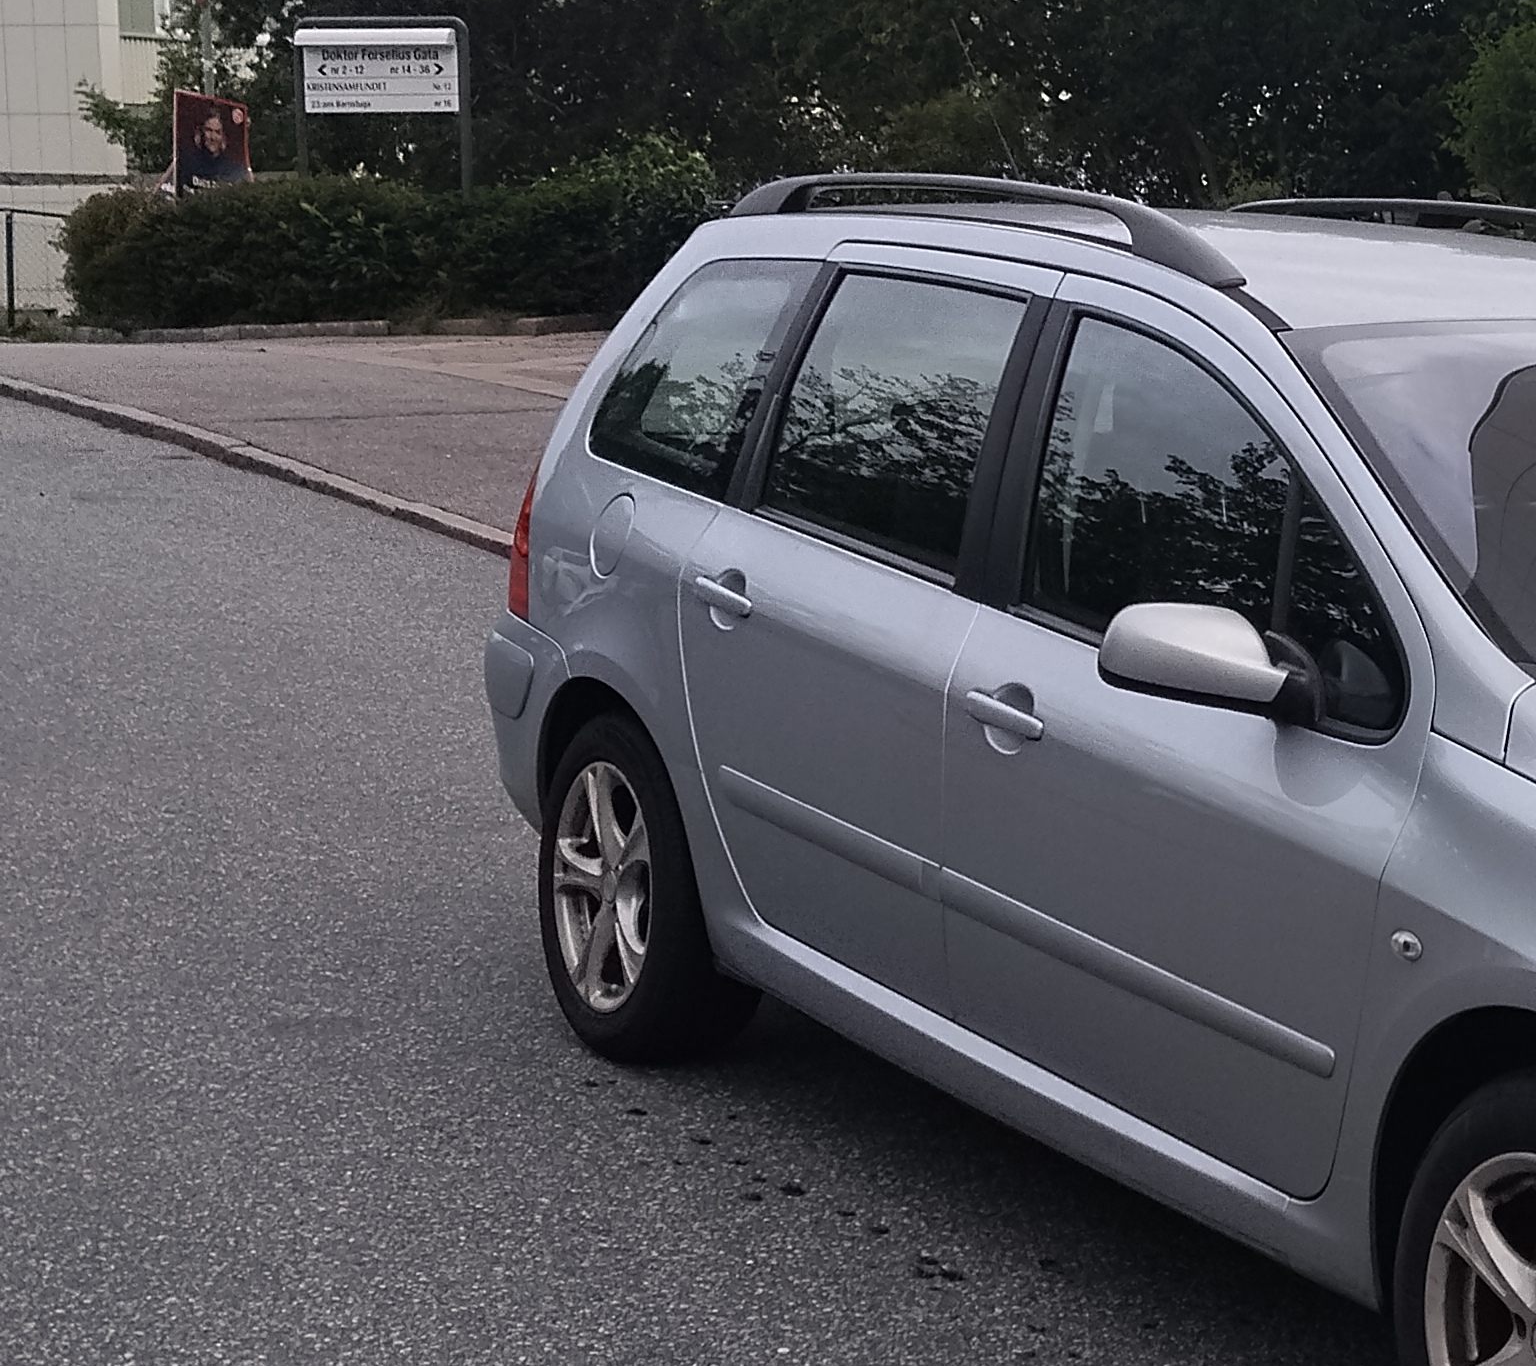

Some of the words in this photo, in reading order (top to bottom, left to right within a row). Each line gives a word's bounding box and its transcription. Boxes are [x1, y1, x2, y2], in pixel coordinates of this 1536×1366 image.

[322, 49, 358, 61] Doktor
[413, 48, 439, 61] Gata
[355, 65, 364, 74] 12
[402, 65, 411, 74] 14
